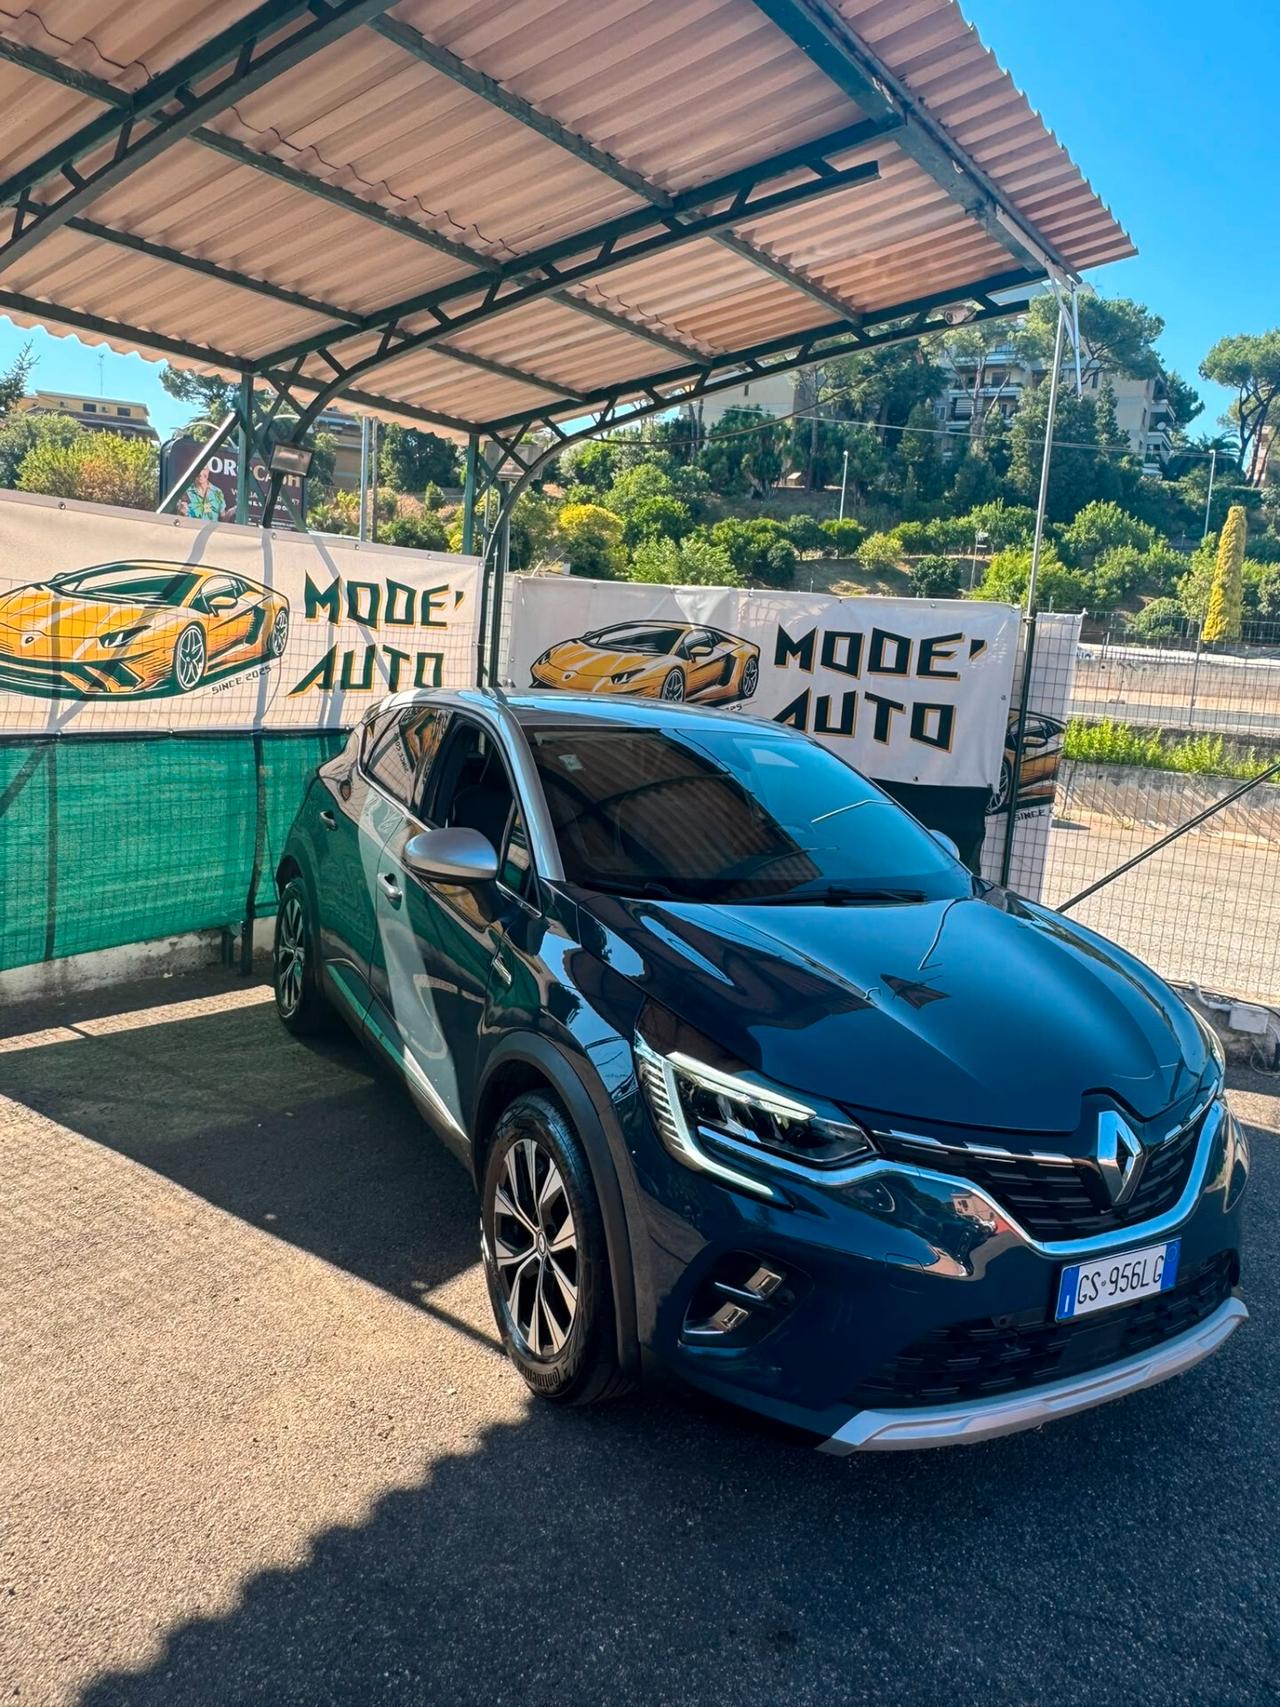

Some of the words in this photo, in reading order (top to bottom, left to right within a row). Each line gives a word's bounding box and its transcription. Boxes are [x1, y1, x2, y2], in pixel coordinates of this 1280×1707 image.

[211, 677, 242, 695] SINCE
[245, 664, 272, 681] 2025
[287, 641, 445, 699] AUTO
[772, 687, 957, 753] AUTO
[1077, 1271, 1101, 1305] GS
